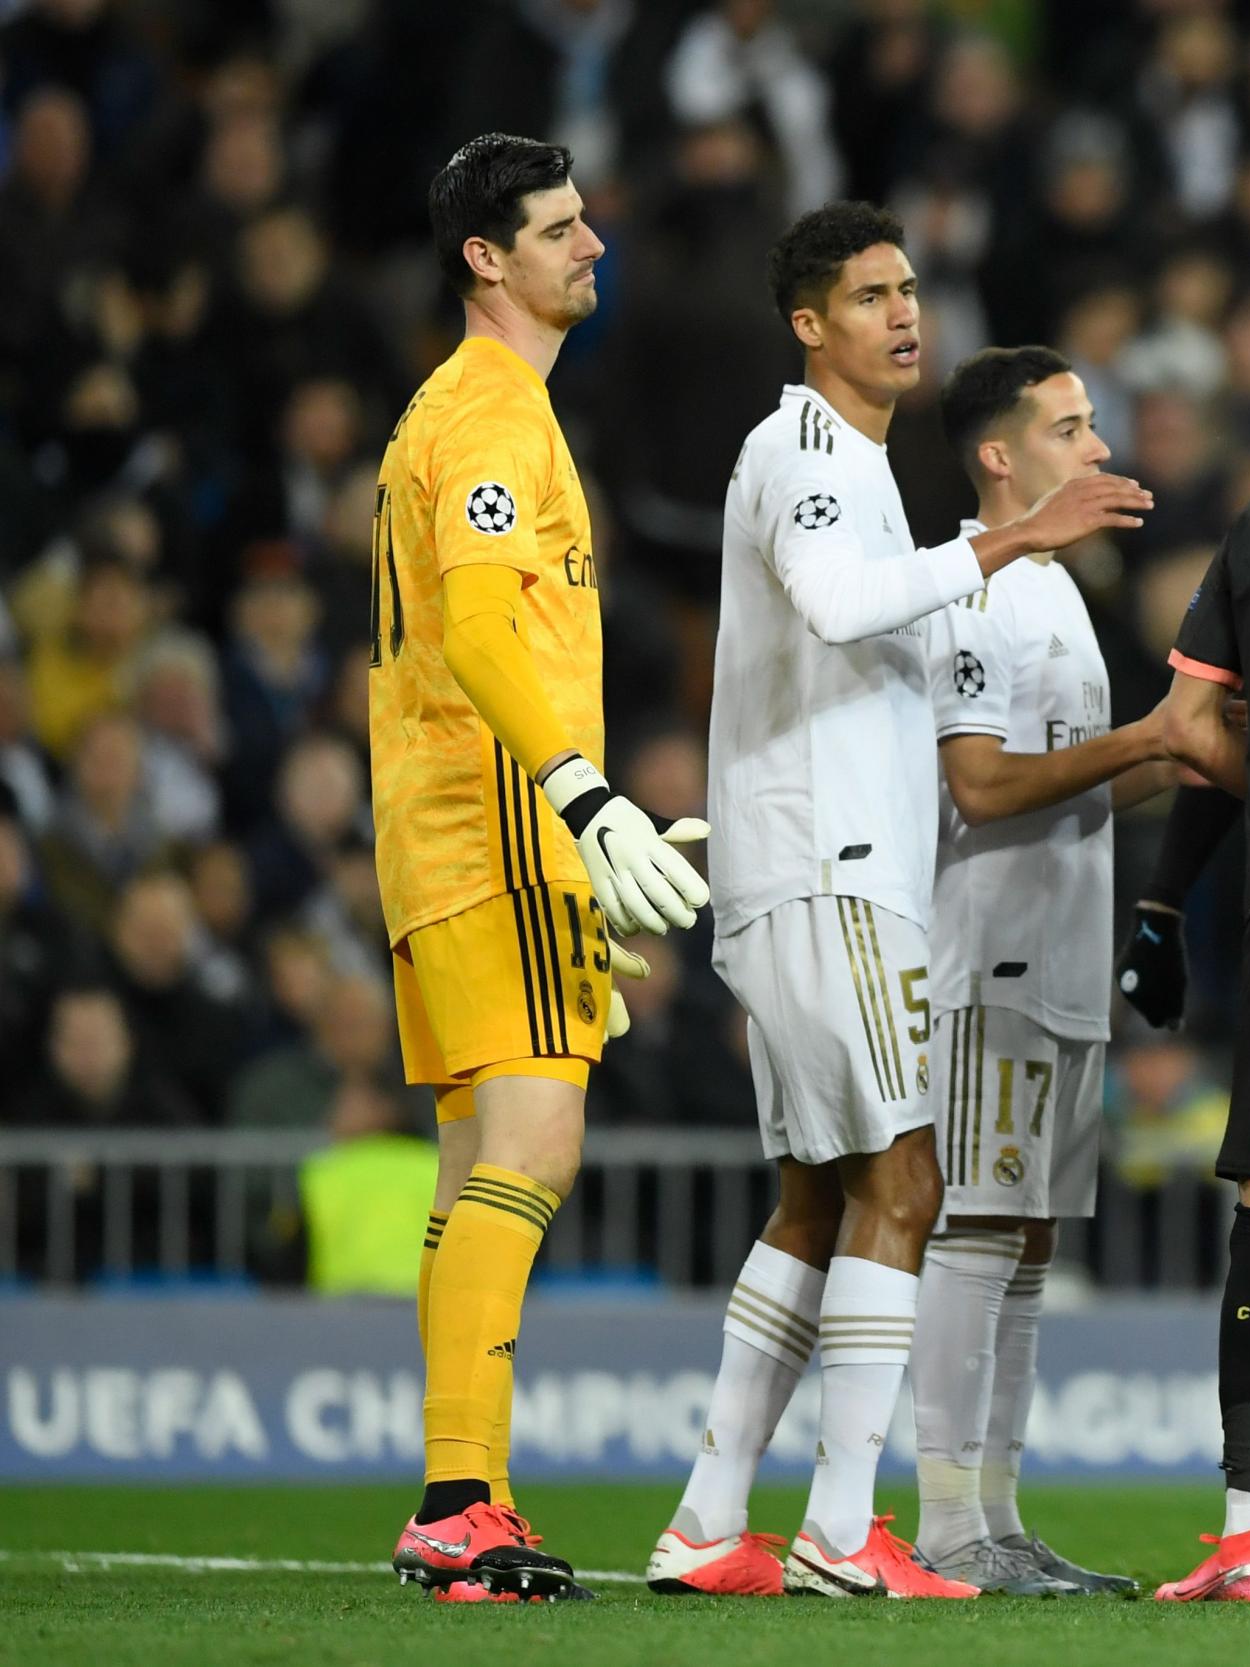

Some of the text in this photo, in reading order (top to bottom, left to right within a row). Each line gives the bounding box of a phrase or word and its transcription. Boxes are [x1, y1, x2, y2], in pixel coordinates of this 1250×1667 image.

[562, 891, 612, 975] 13
[899, 966, 931, 1045] 5
[995, 1057, 1054, 1138] 17
[8, 1366, 269, 1460] UEFA
